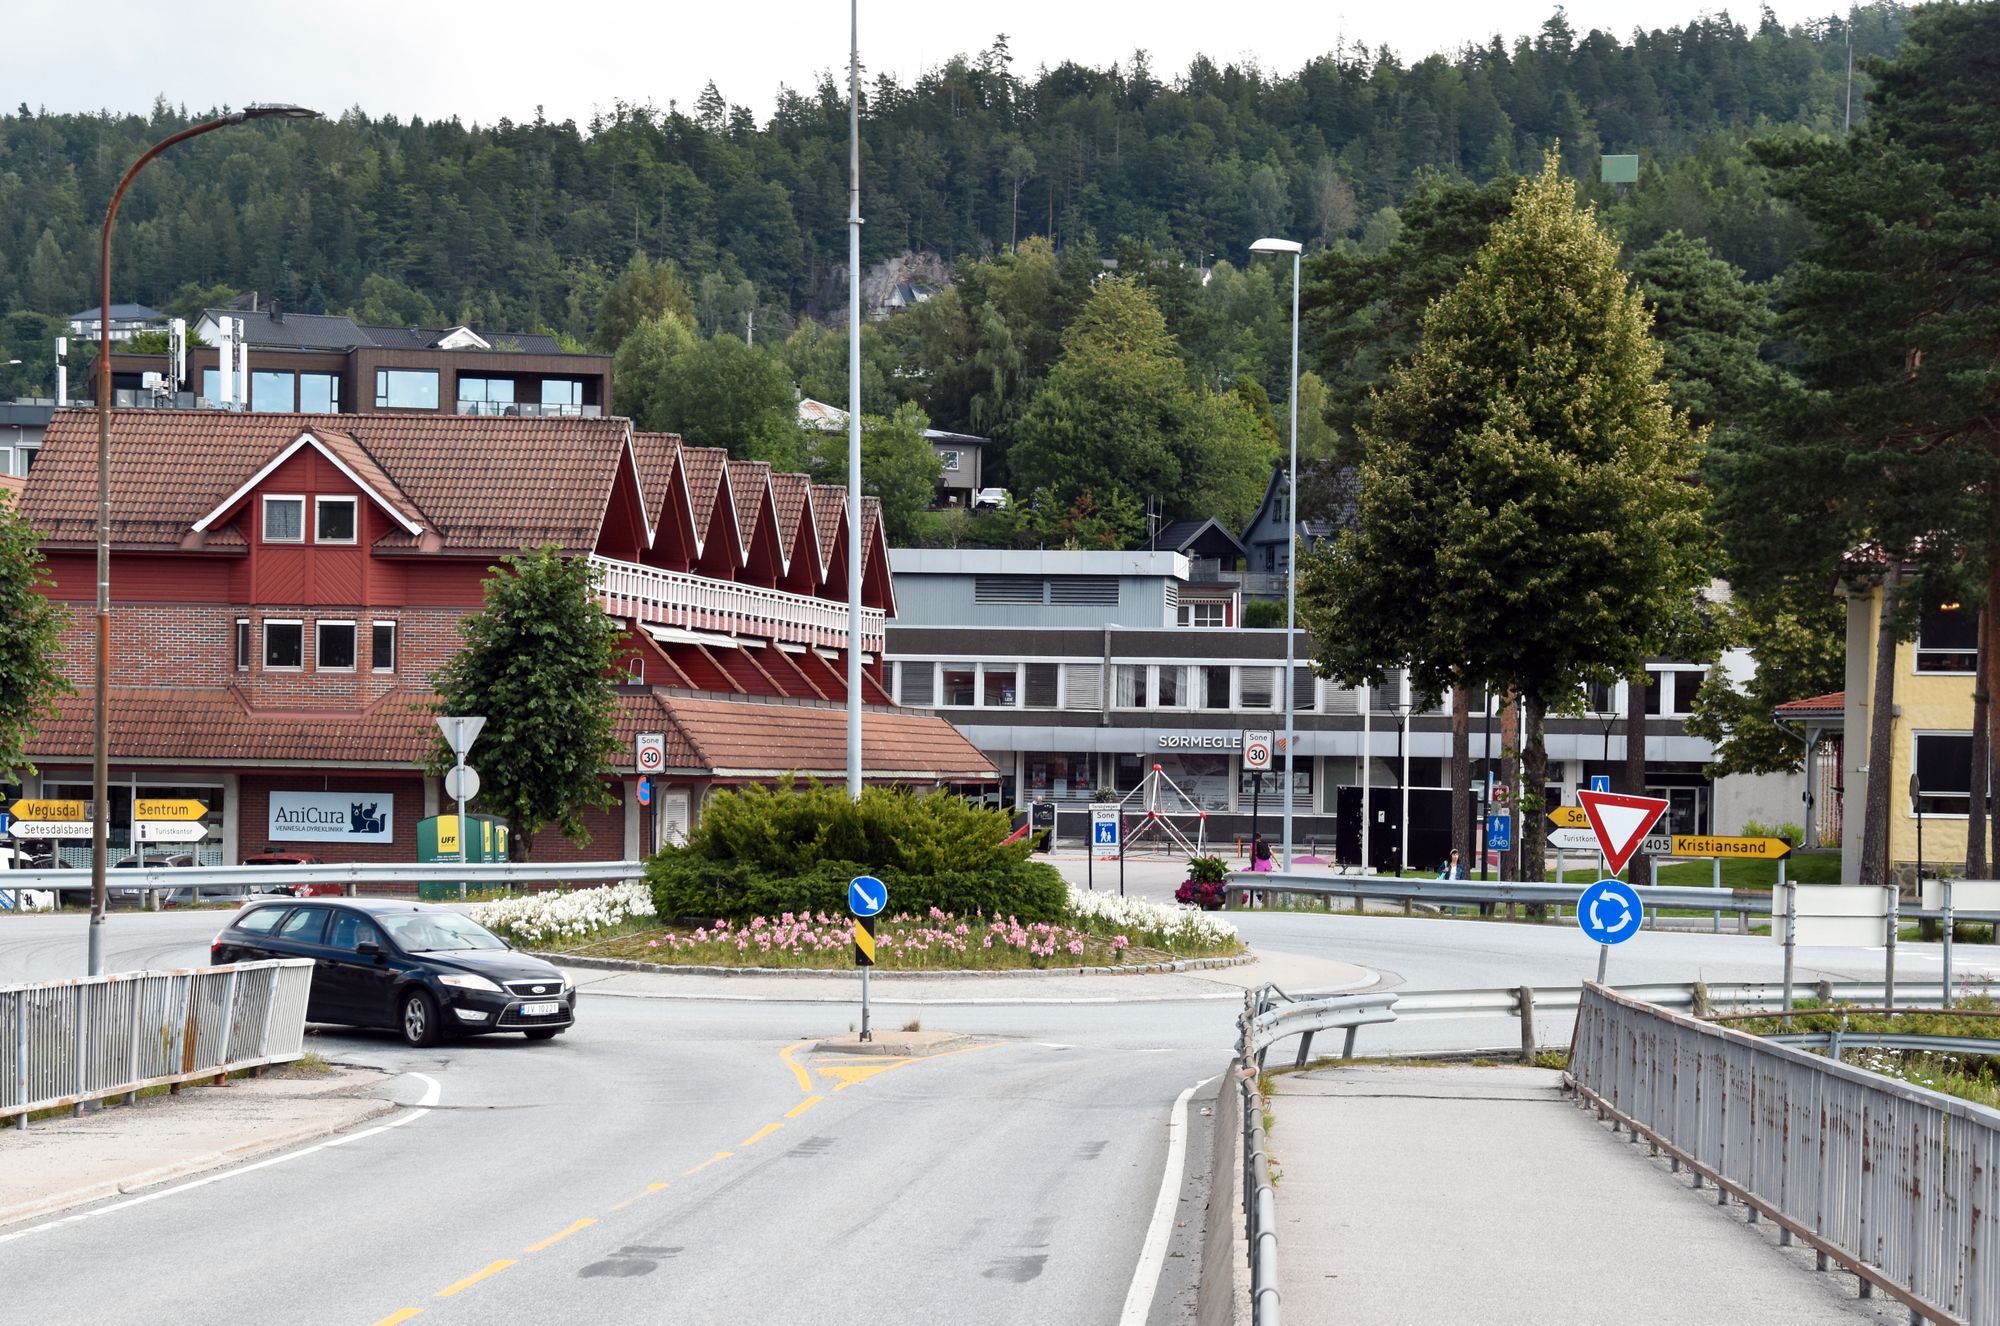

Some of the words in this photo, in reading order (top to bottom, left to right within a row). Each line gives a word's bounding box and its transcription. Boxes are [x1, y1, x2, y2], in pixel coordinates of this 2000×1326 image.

[1249, 733, 1268, 741] Sone
[644, 752, 658, 763] 30
[1250, 749, 1265, 760] 30
[27, 803, 79, 819] Vegusdal
[138, 802, 189, 816] Sentrum
[275, 806, 345, 824] AniCura
[1096, 811, 1115, 819] Sone
[306, 825, 344, 833] DYREKLINIKK
[441, 836, 456, 844] UFF
[1645, 839, 1670, 850] 405
[1678, 838, 1766, 853] Kristiansand
